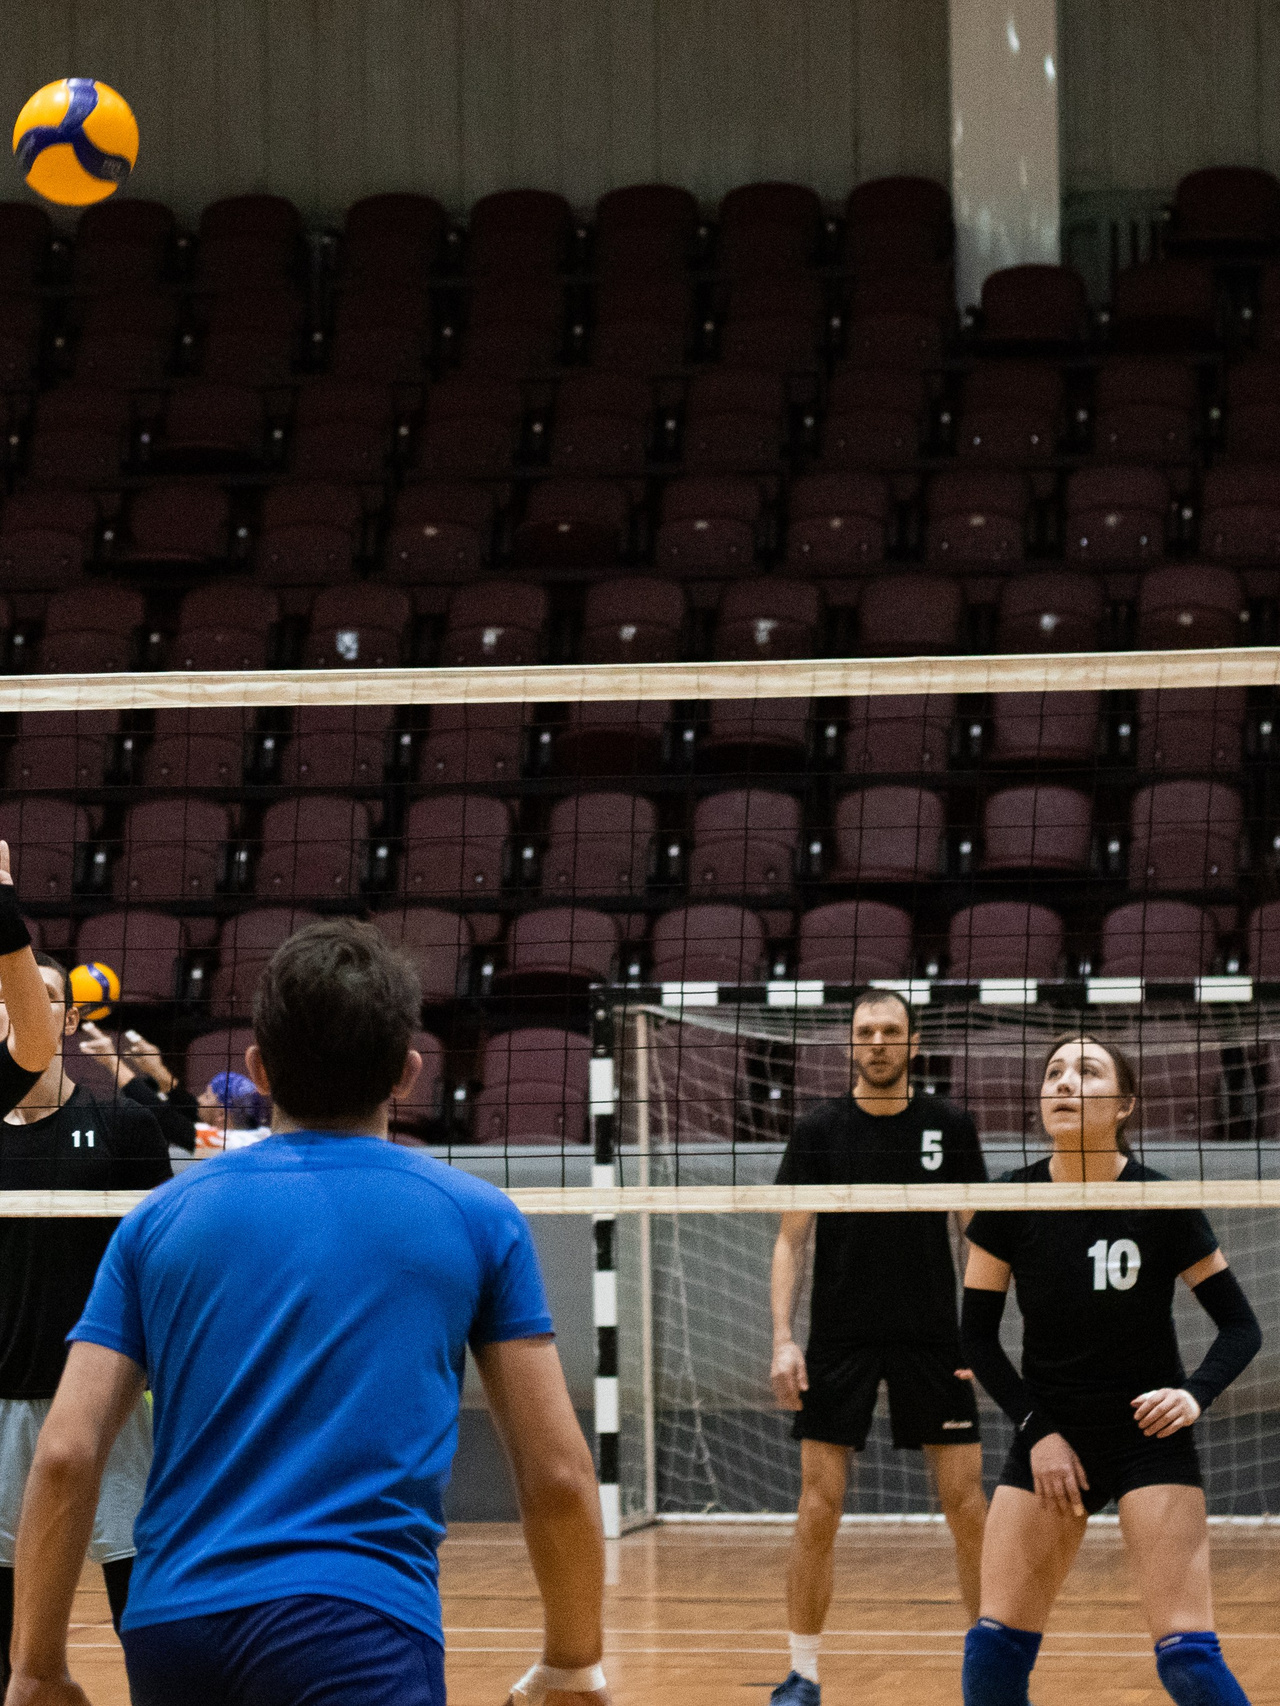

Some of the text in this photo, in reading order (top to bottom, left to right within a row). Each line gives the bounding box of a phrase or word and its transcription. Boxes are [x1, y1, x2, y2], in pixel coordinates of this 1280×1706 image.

[71, 1130, 95, 1148] 11
[921, 1129, 944, 1171] 5
[1087, 1238, 1142, 1291] 10
